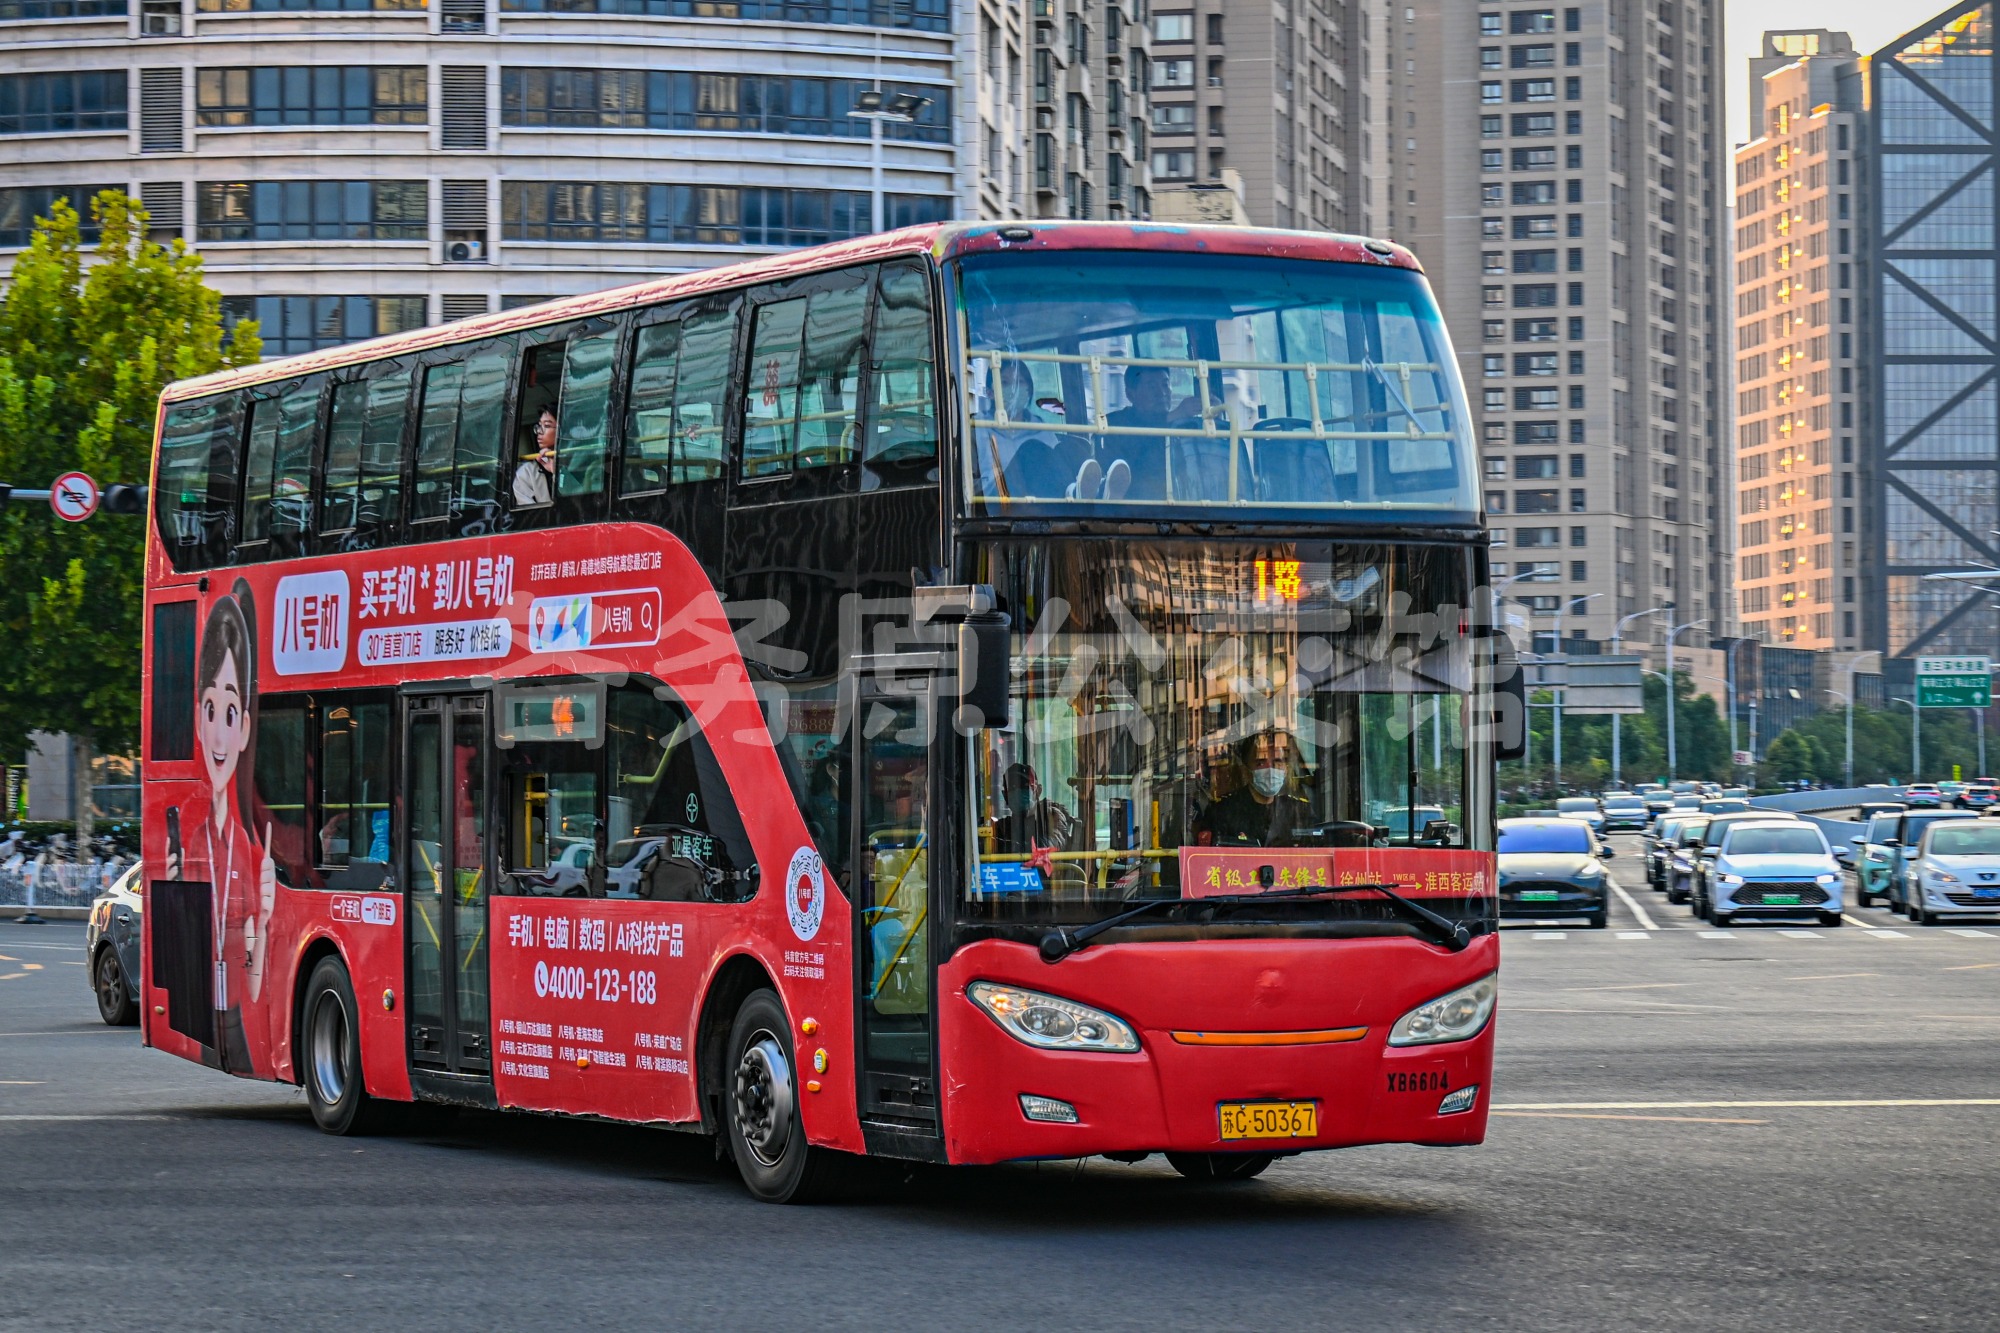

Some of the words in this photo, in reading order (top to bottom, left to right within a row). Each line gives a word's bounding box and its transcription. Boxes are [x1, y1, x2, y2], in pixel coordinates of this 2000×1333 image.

[1254, 559, 1301, 601] 1路
[281, 593, 339, 653] 八号机
[602, 606, 632, 633] 八号机
[434, 627, 466, 656] 服务好
[470, 624, 502, 654] 价格低
[671, 834, 713, 861] 亚星客车
[1203, 866, 1327, 888] 省级工先锋号
[1340, 871, 1382, 886] 徐州站
[1425, 871, 1485, 892] 淮西客运站
[798, 888, 811, 899] 八号机
[508, 914, 534, 947] 手机
[544, 916, 569, 950] 电脑
[579, 918, 605, 952] 数码
[615, 920, 684, 957] Ai科技产品
[785, 950, 824, 966] 抖音官方号二维码
[548, 965, 657, 1005] 4000-123-188
[1387, 1071, 1448, 1093] XB6604
